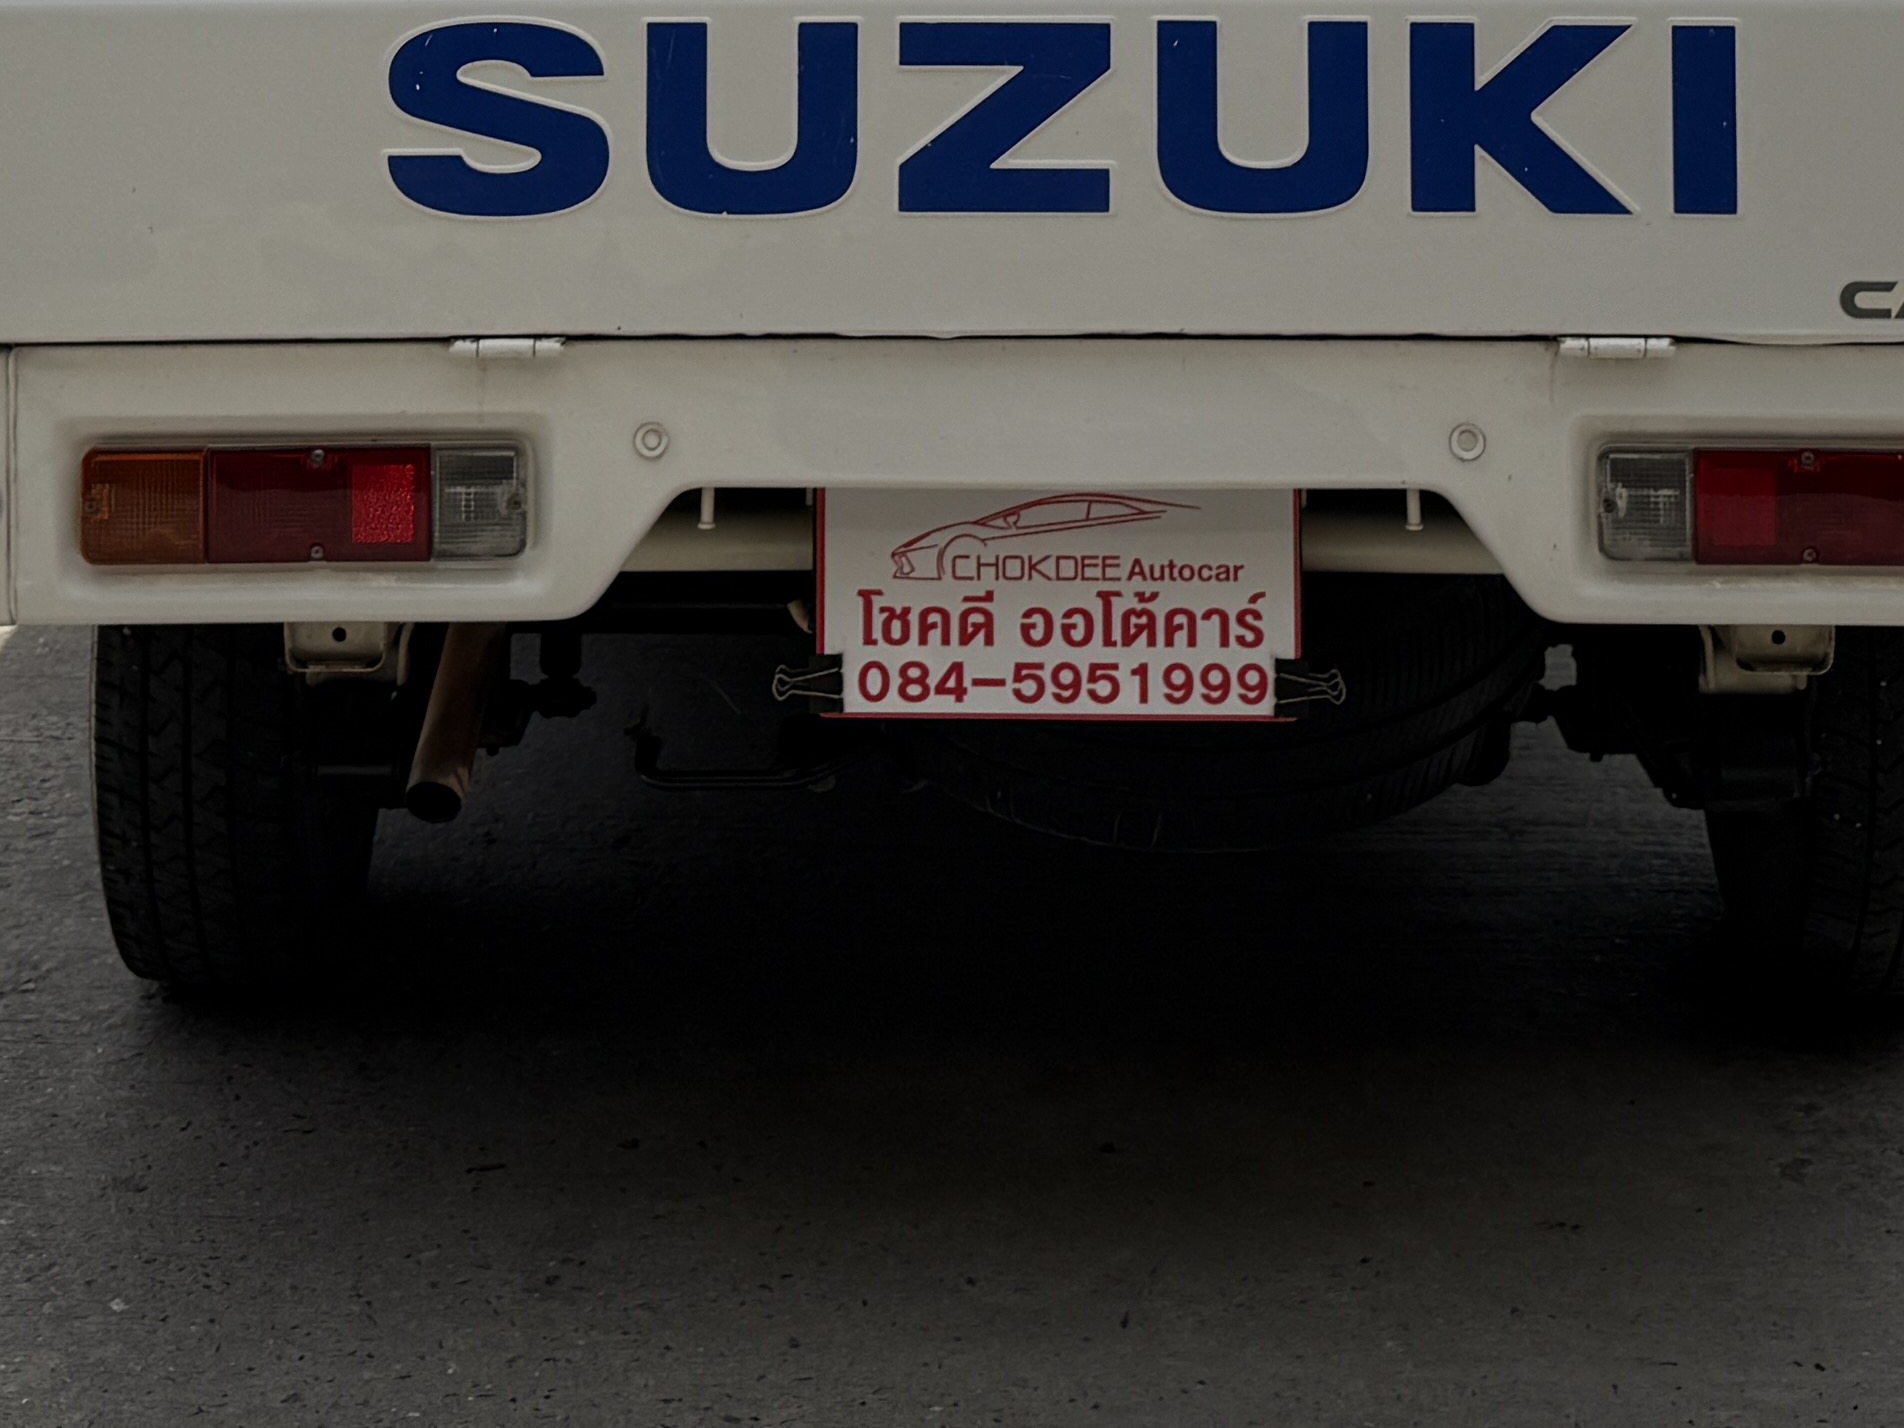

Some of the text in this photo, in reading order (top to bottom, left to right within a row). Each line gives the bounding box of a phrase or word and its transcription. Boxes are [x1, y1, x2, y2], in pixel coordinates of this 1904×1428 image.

[391, 22, 1738, 216] SUZUKI
[951, 554, 1244, 582] CHOKDEE Autocar
[858, 589, 1267, 650] โชคดี ออโต้คาร์
[858, 661, 1270, 706] 084-5951999
